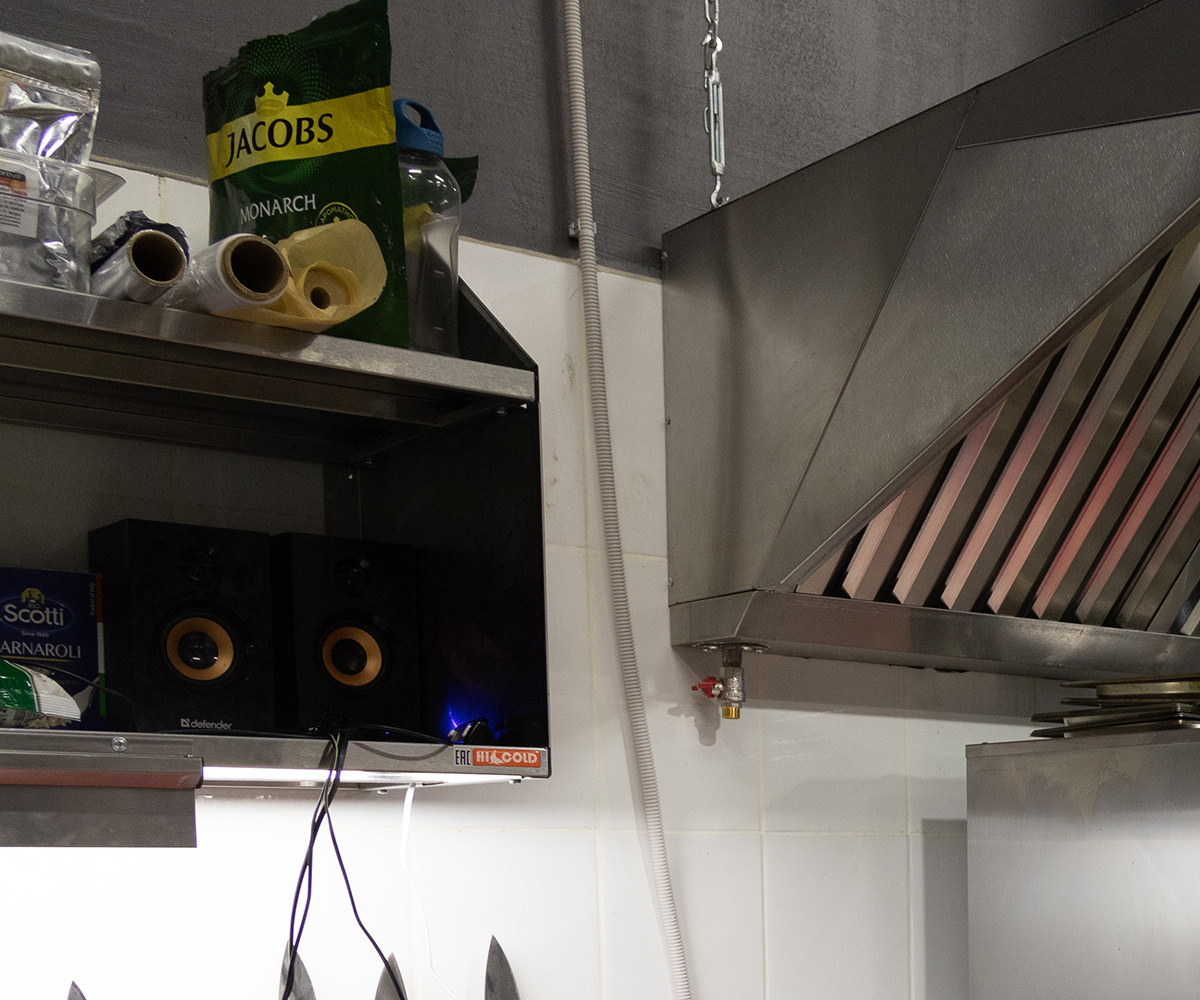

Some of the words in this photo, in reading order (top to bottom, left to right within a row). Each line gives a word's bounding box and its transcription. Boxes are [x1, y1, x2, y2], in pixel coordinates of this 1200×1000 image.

[225, 113, 333, 168] JACOBS
[240, 194, 316, 224] MONARCH
[4, 604, 64, 626] Scotti
[0, 641, 81, 658] ARNAROLI
[190, 719, 232, 730] defender
